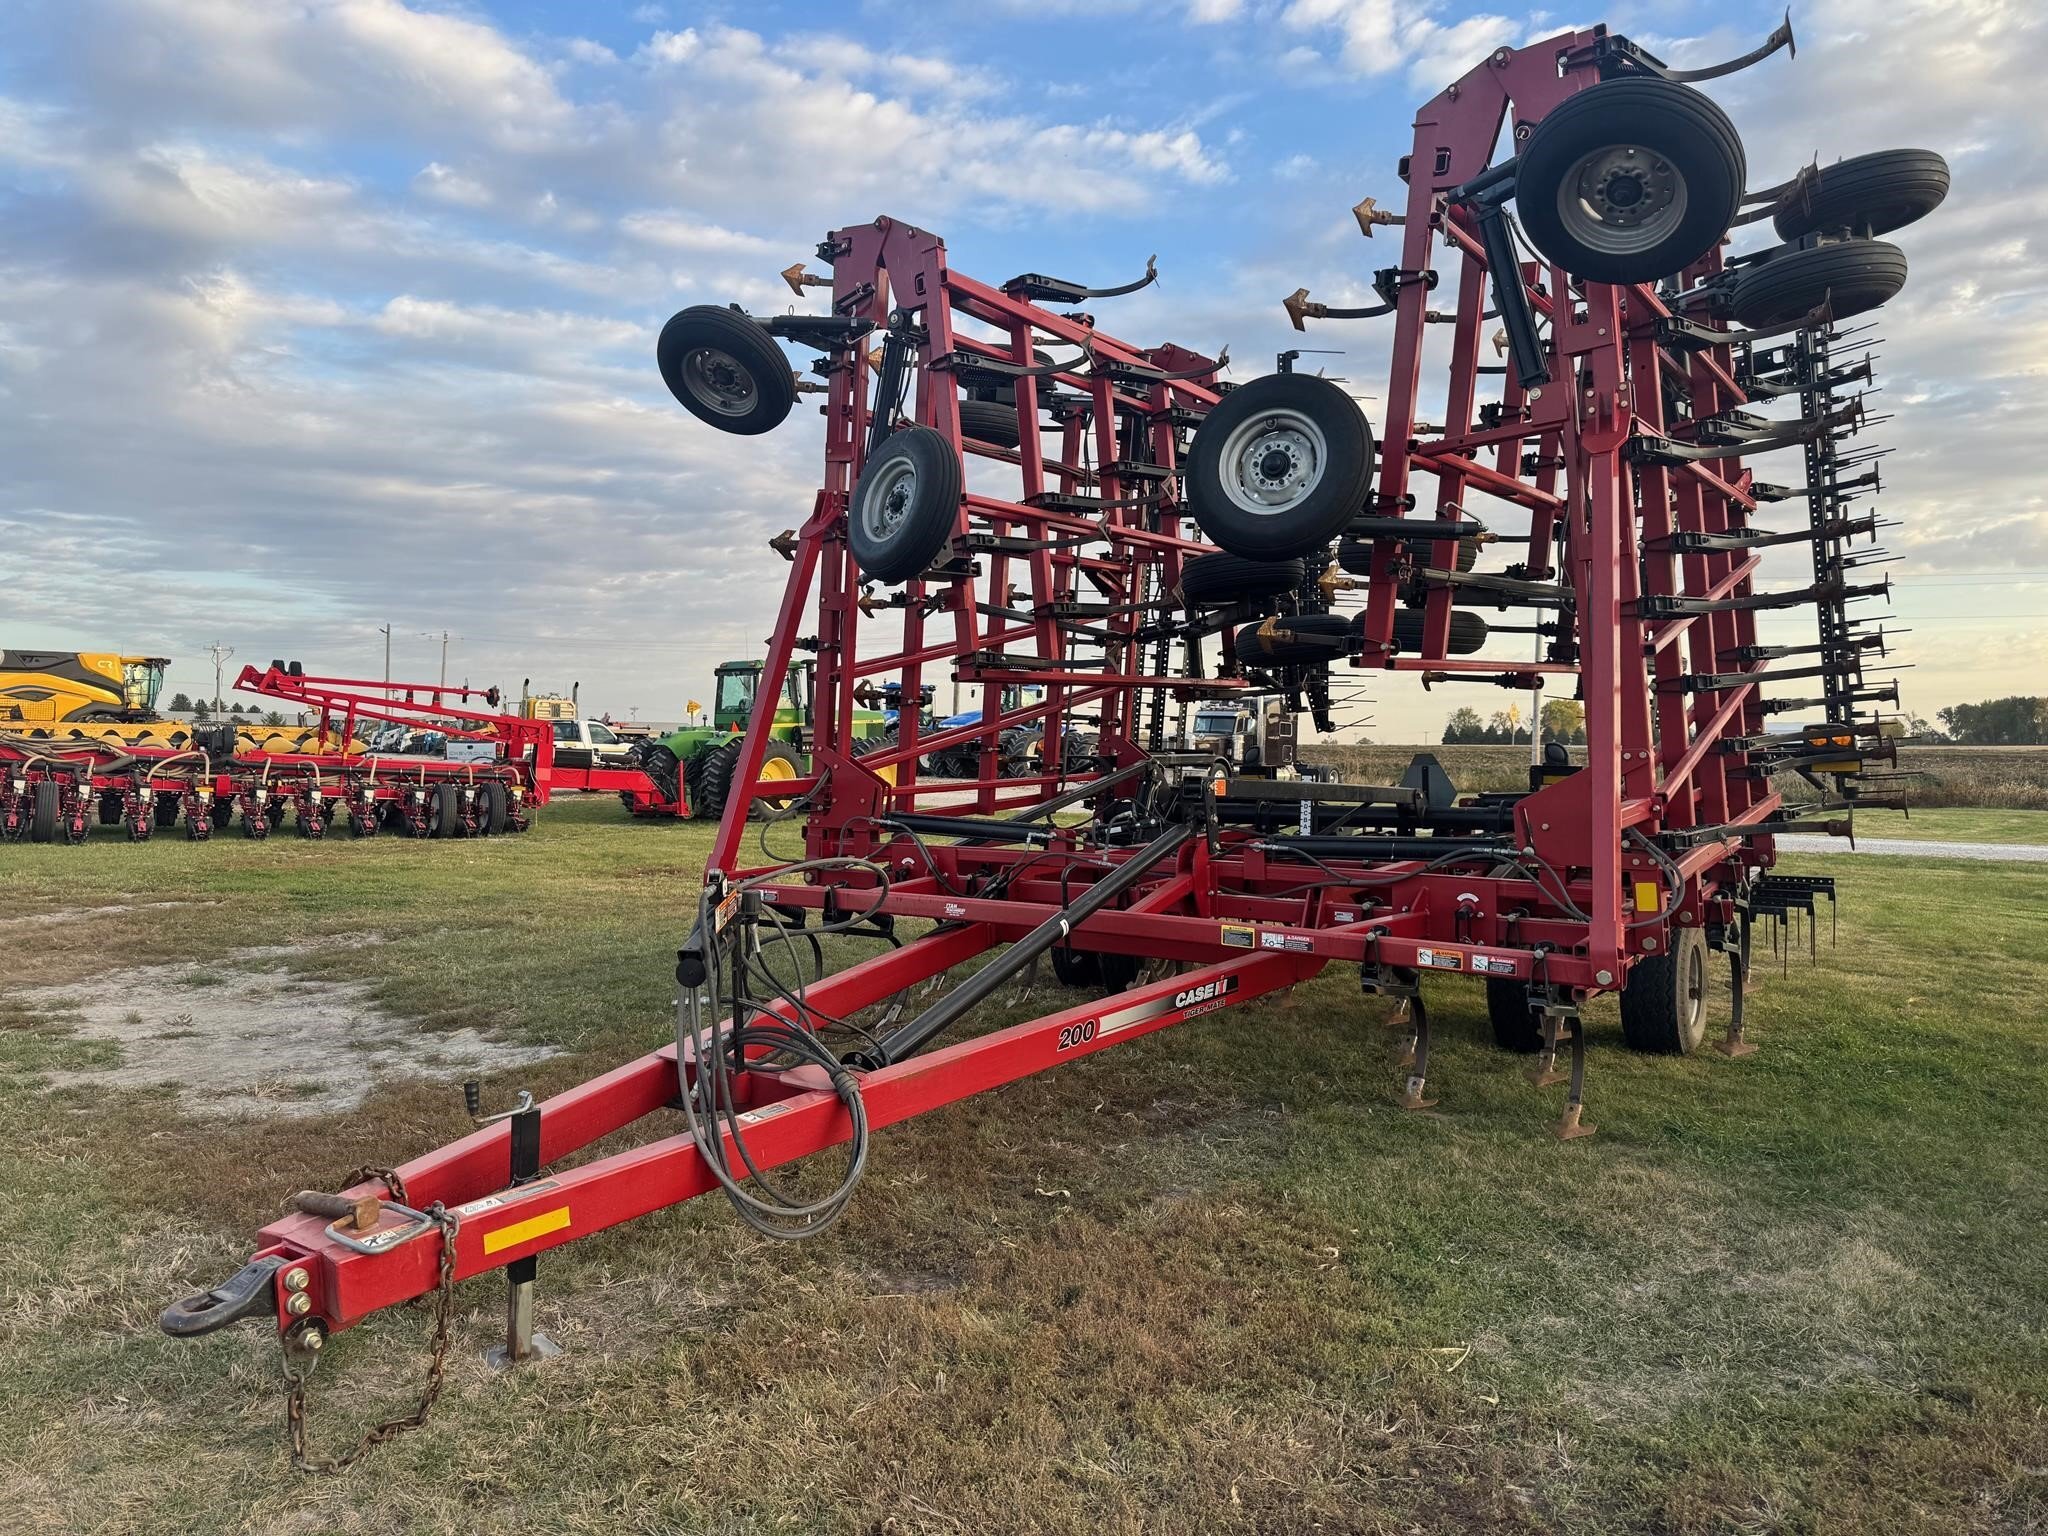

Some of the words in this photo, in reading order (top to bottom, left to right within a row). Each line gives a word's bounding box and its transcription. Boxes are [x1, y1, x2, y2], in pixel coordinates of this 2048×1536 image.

[97, 660, 113, 669] CR
[1175, 984, 1215, 1008] CASE
[1183, 999, 1227, 1020] TIGER-MATE
[1057, 1019, 1096, 1052] 200
